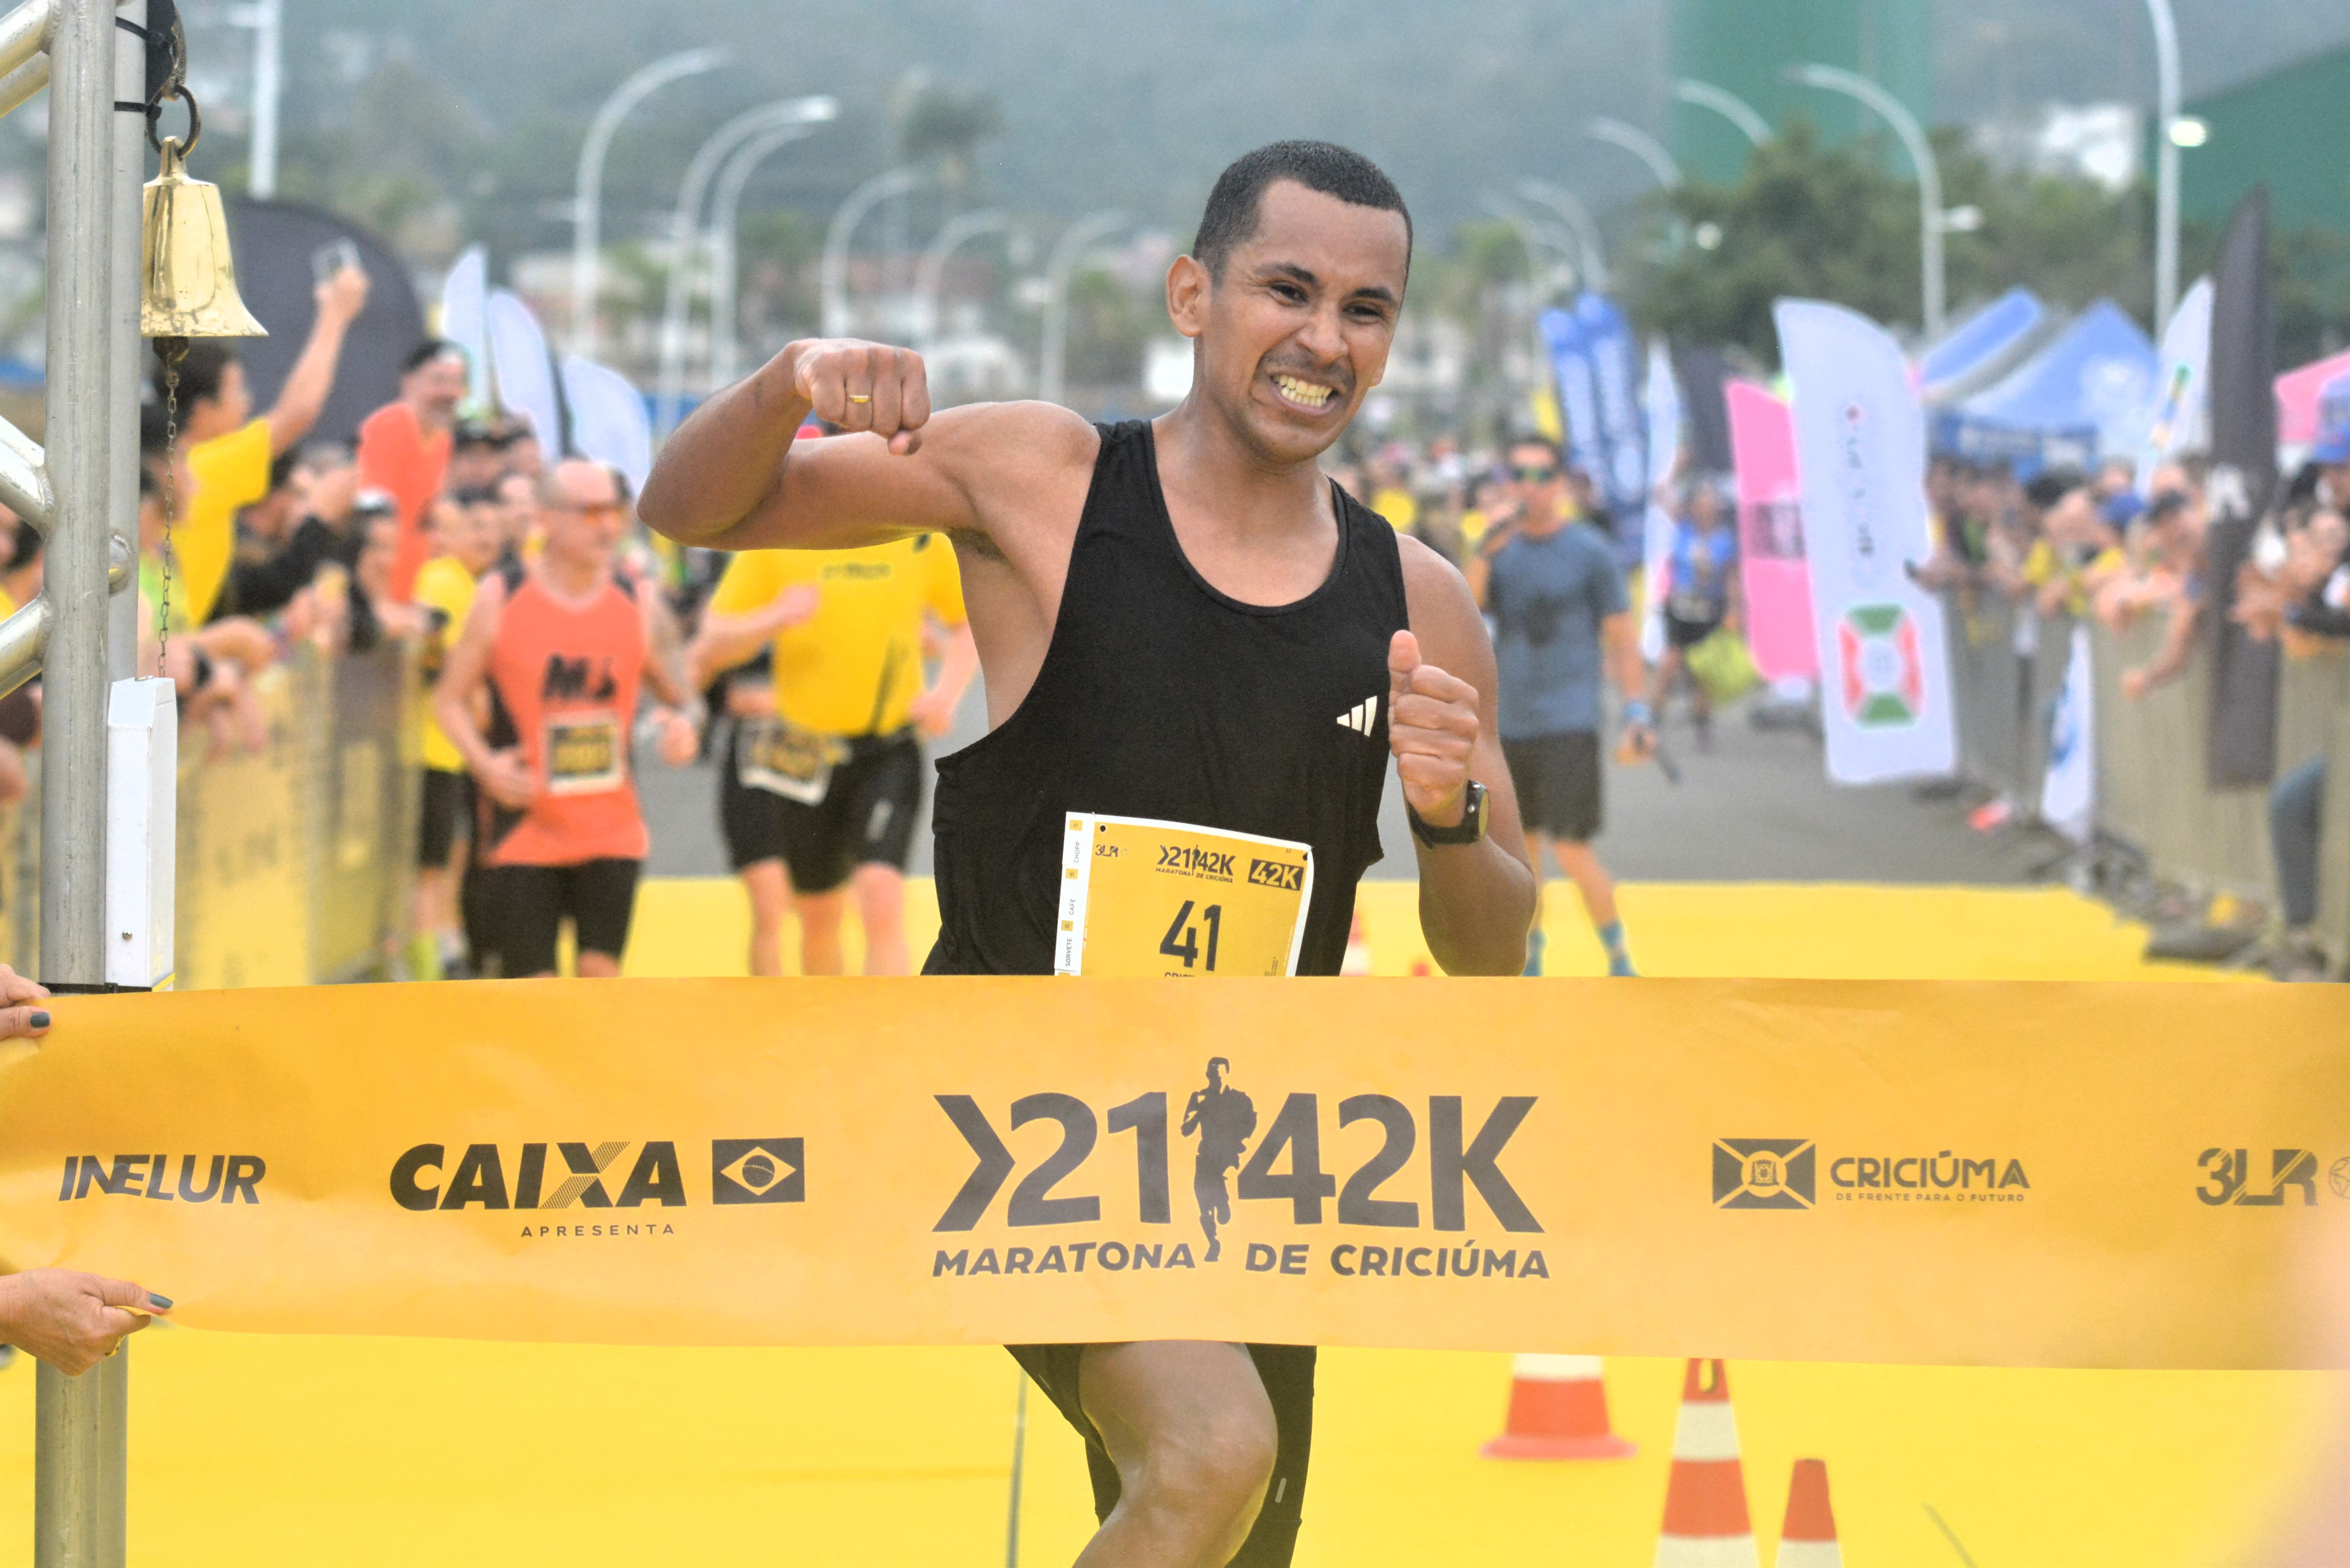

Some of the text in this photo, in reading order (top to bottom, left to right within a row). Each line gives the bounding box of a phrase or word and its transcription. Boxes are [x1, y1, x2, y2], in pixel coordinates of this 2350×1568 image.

[1156, 868, 1191, 876] MARATONA
[1206, 874, 1233, 883] CRICIÚMA
[1251, 862, 1300, 889] 42K
[1159, 900, 1222, 971] 41
[59, 1155, 266, 1204] INELUR
[390, 1141, 687, 1211] CAIXA
[1830, 1150, 2031, 1189] CRICIÚMA
[521, 1224, 674, 1237] APRESENTA
[932, 1239, 1550, 1279] MARATONA DE CRICIÚMA
